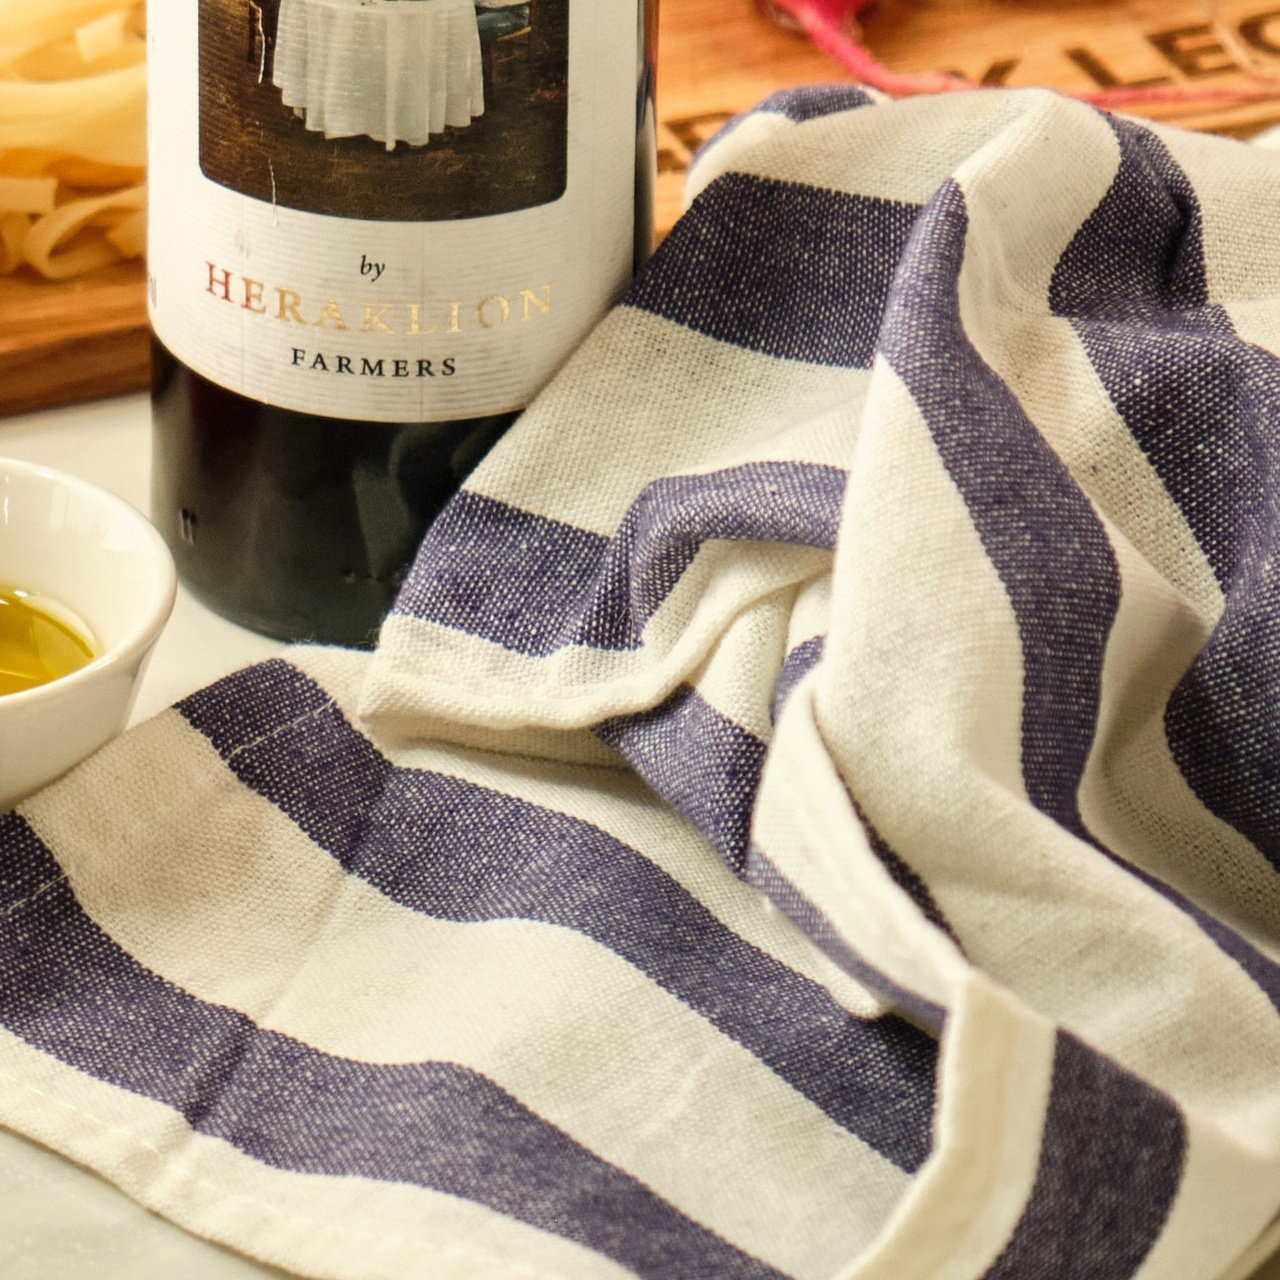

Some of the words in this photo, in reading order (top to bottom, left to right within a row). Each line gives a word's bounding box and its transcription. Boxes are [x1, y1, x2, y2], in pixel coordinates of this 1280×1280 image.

[359, 254, 387, 282] by
[204, 260, 555, 336] HERAKLION
[290, 347, 458, 378] FARMERS
